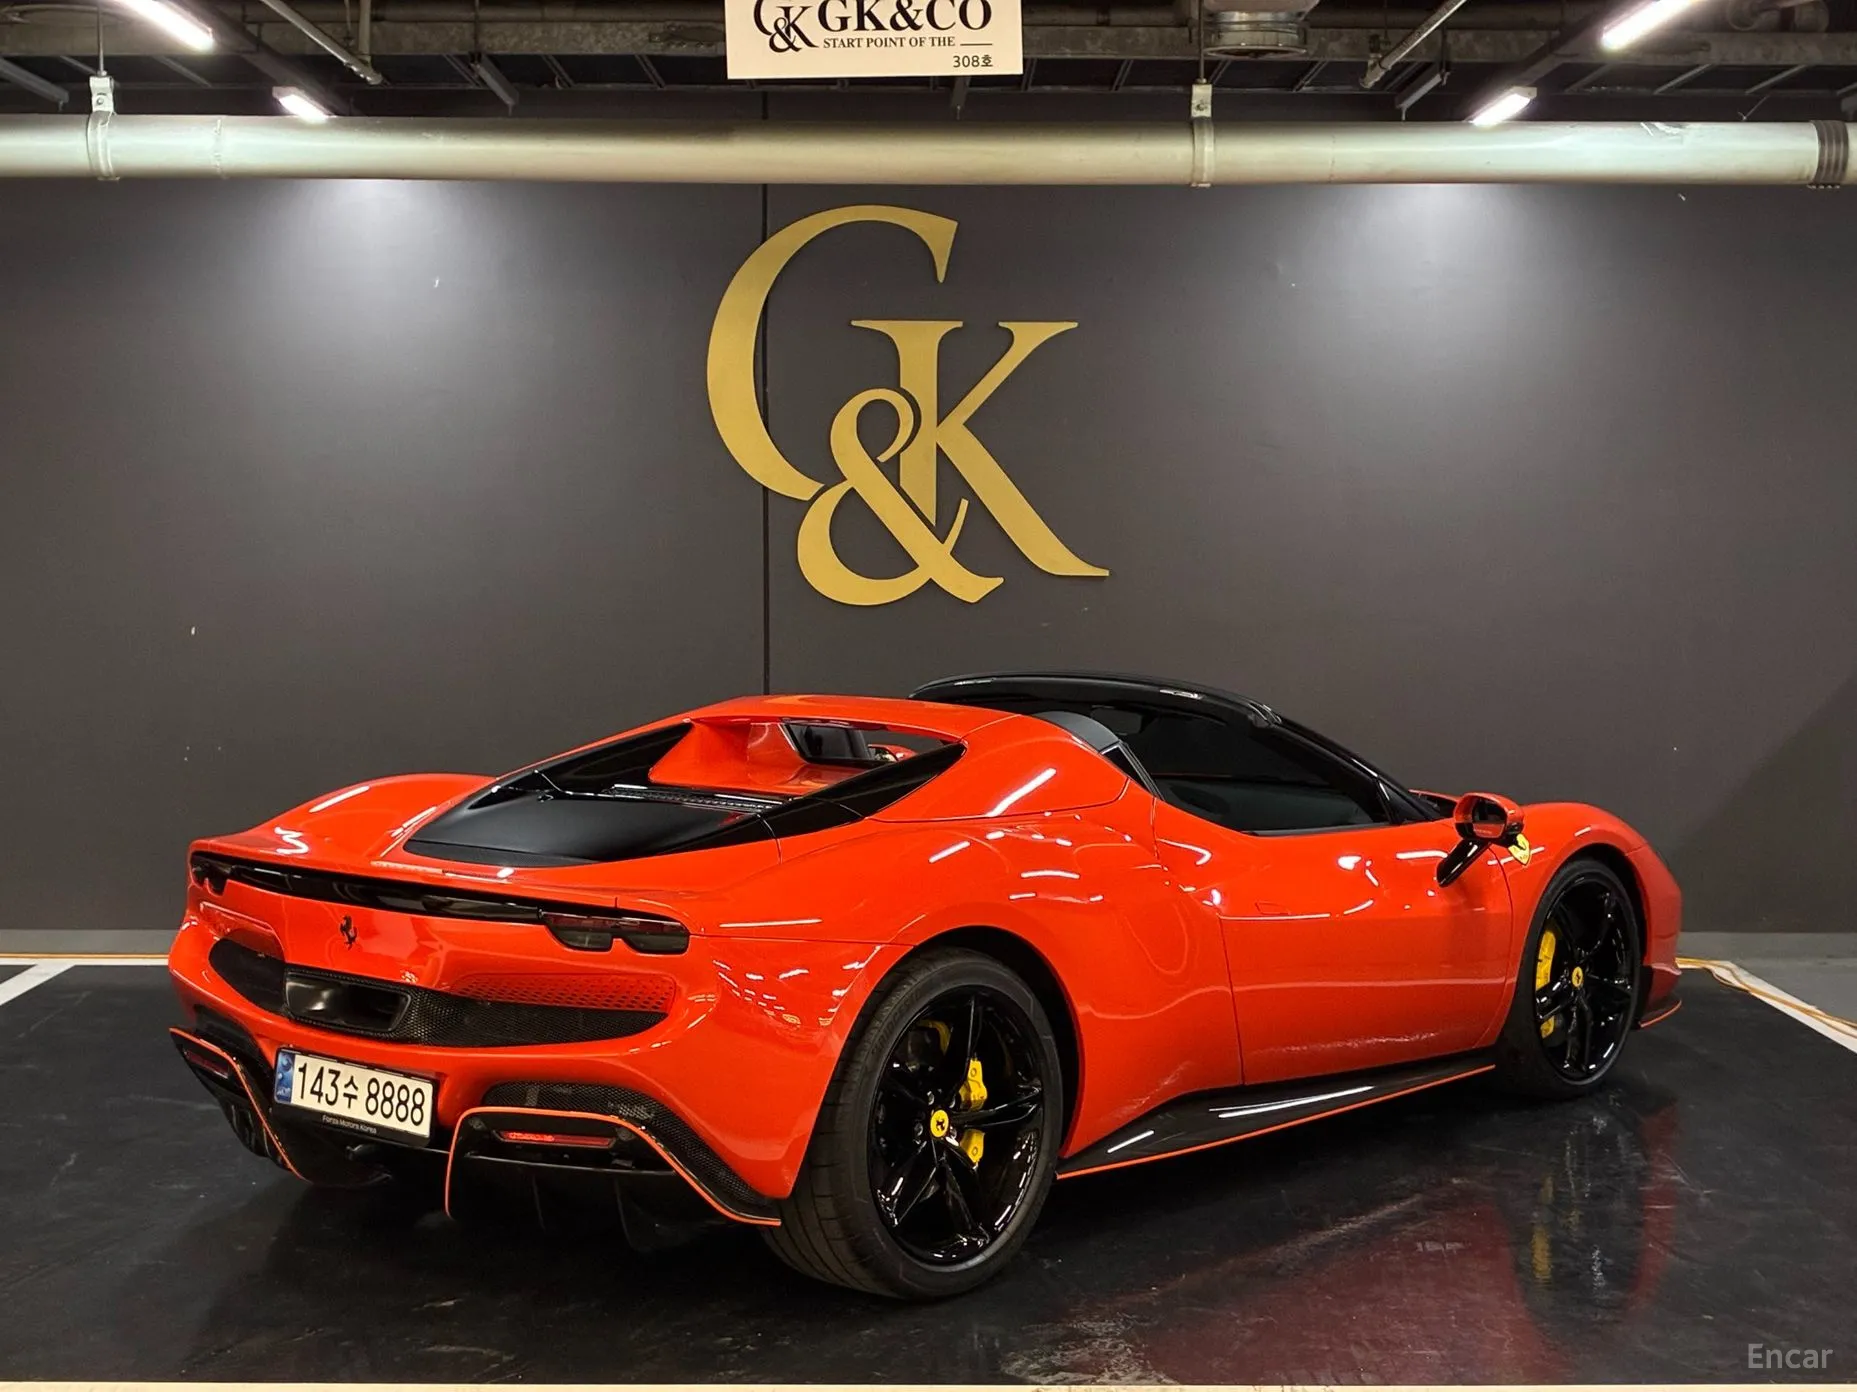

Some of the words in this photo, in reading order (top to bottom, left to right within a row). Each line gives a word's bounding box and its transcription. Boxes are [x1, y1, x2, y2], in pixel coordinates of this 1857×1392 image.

[818, 0, 992, 32] GK&CO
[823, 37, 863, 48] START
[866, 37, 906, 48] POINT
[909, 37, 926, 47] OF
[929, 36, 955, 47] THE
[953, 54, 993, 68] 308호
[298, 1062, 358, 1109] 143수
[365, 1077, 425, 1126] 8888
[360, 1124, 377, 1134] Korea
